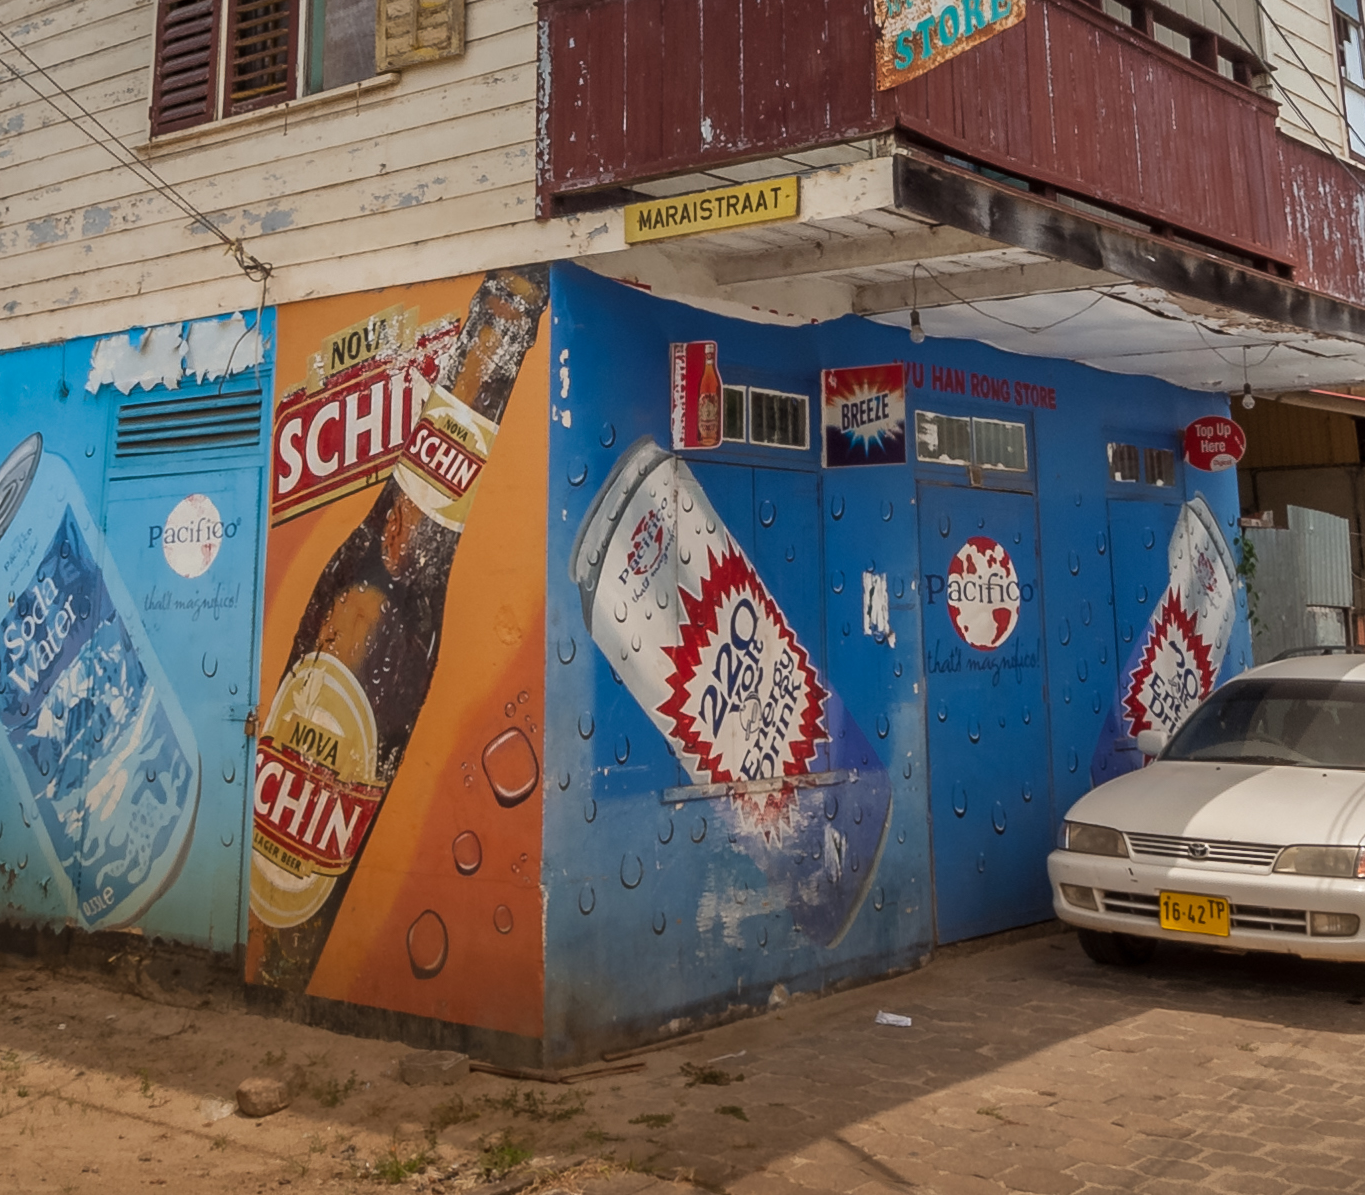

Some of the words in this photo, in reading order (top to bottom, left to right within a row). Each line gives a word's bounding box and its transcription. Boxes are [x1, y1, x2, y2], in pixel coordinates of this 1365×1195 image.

[638, 186, 782, 232] MARAISTRAAT
[931, 364, 967, 395] HAN
[970, 371, 1011, 403] RONG
[1014, 380, 1057, 410] STORE
[445, 418, 469, 442] NOVA
[840, 390, 890, 431] BREEZE
[1195, 424, 1214, 439] Top
[1216, 422, 1231, 438] Up
[409, 428, 479, 490] SCHIN
[1200, 439, 1226, 453] Here
[148, 517, 238, 548] Pacifico
[924, 572, 1034, 605] Pacifico
[3, 577, 59, 662] Soda
[8, 593, 78, 696] Water
[698, 598, 758, 739] 220
[740, 648, 795, 781] Energy
[760, 675, 802, 780] Drink
[290, 721, 339, 766] NOVA
[254, 753, 363, 859] CHIN
[253, 832, 280, 859] LAGER
[280, 851, 302, 873] BEER
